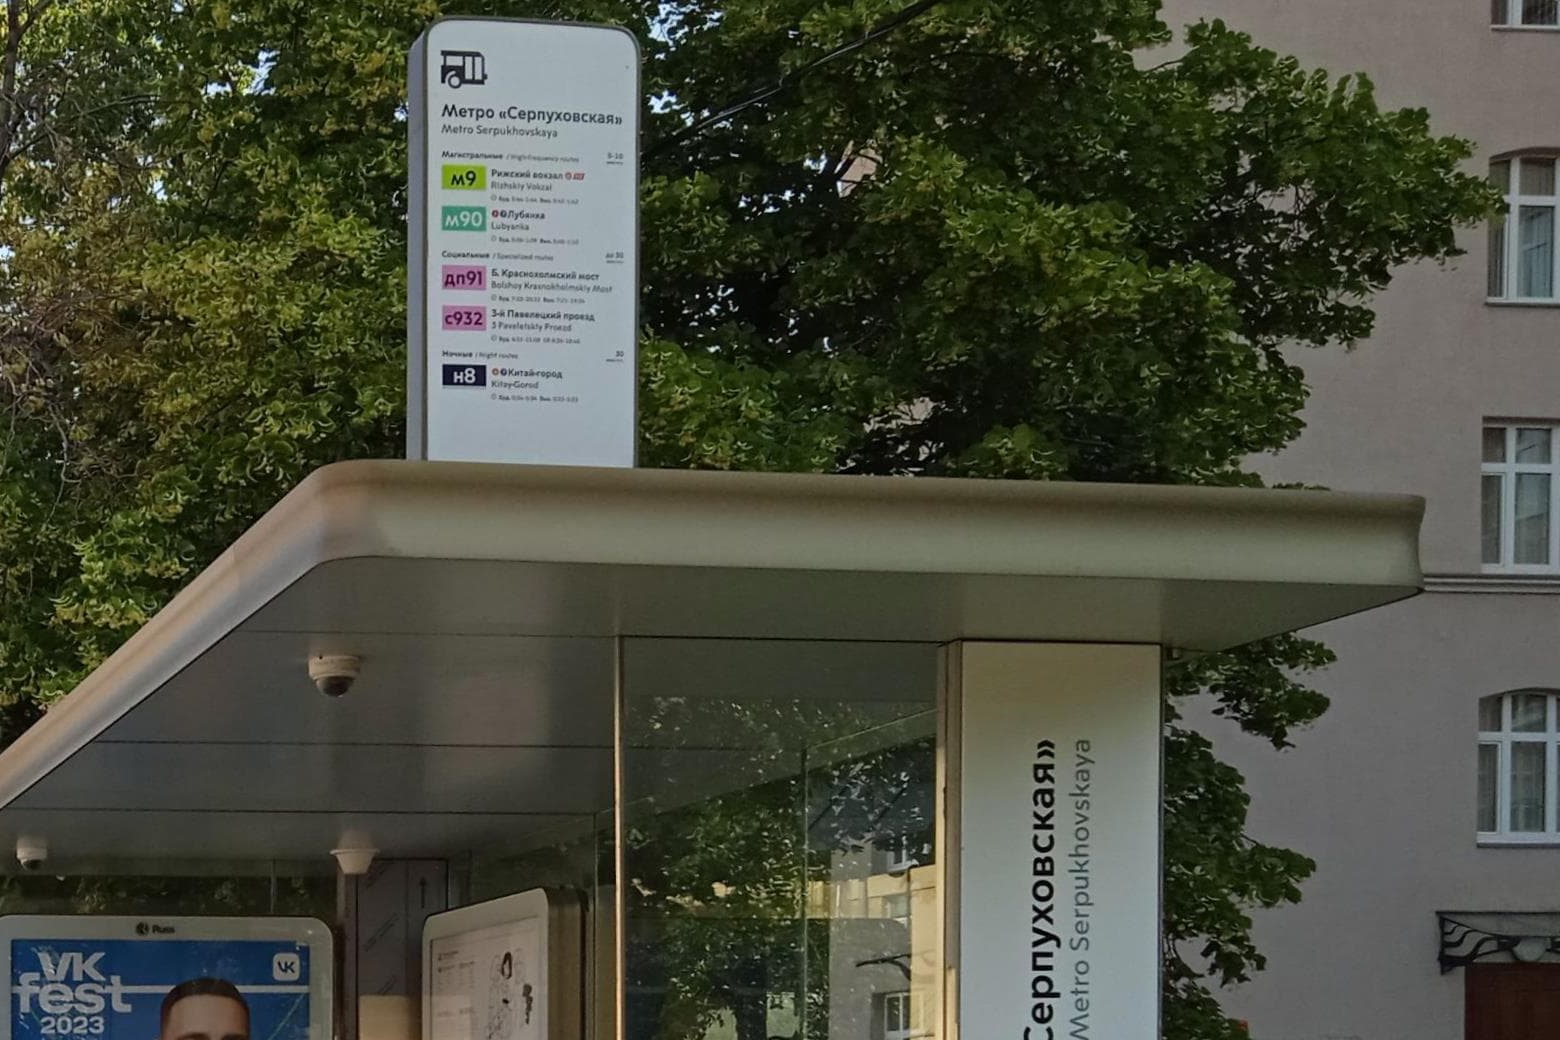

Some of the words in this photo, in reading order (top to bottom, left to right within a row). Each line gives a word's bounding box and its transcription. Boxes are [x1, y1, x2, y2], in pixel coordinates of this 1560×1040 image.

[441, 104, 495, 121] Метро
[499, 106, 622, 126] «Серпуховская»
[441, 124, 474, 135] Metro
[476, 126, 558, 138] Serpukhovskaya
[450, 170, 477, 186] м9
[491, 169, 531, 179] Рижский
[532, 172, 564, 180] вокзал
[491, 181, 525, 191] Rizhskiy
[445, 211, 483, 227] м90
[508, 210, 546, 221] Лубянка
[491, 223, 530, 232] Lubyanka
[444, 271, 483, 287] дп91
[501, 270, 577, 281] Краснохолмский
[444, 311, 484, 326] с932
[507, 310, 562, 321] Павелецкий
[563, 313, 596, 323] проезд
[453, 368, 477, 384] н8
[508, 368, 563, 379] Китай-город
[1068, 738, 1097, 952] Serpukhovskaya
[38, 952, 106, 981] VK
[277, 962, 296, 975] VK
[19, 971, 132, 1014] fest
[40, 1016, 104, 1035] 2023
